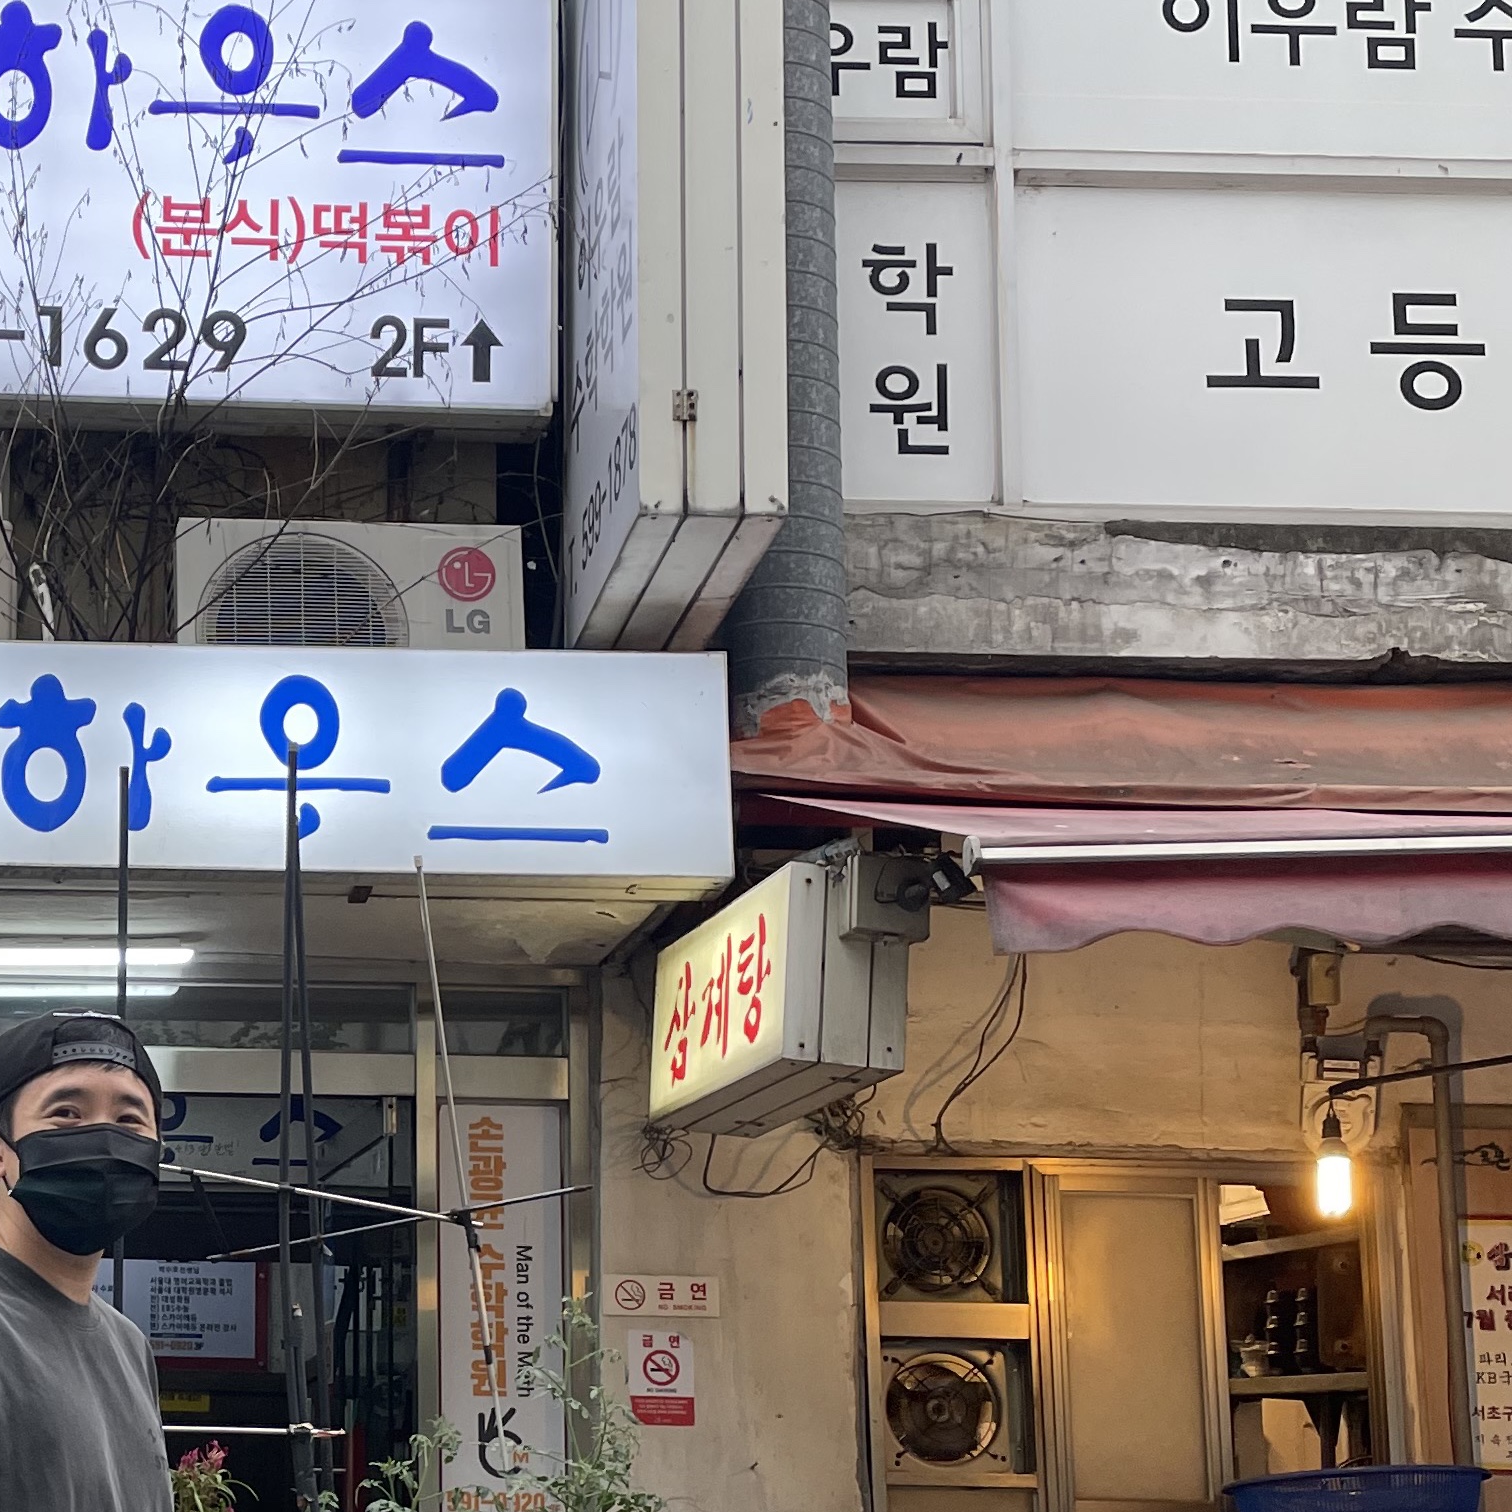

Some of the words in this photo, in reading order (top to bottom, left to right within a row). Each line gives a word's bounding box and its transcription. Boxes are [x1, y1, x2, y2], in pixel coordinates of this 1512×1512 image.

[133, 191, 501, 268] (분식)떡볶이
[578, 117, 626, 299] 이우람
[370, 315, 450, 379] 2F
[569, 218, 634, 454] 수학학원
[582, 400, 639, 572] 599-1878
[445, 608, 491, 635] LG
[664, 913, 772, 1089] 삼계탕
[515, 1244, 533, 1285] Man
[516, 1290, 534, 1311] of
[516, 1314, 534, 1344] the
[673, 1304, 707, 1312] SMOKING
